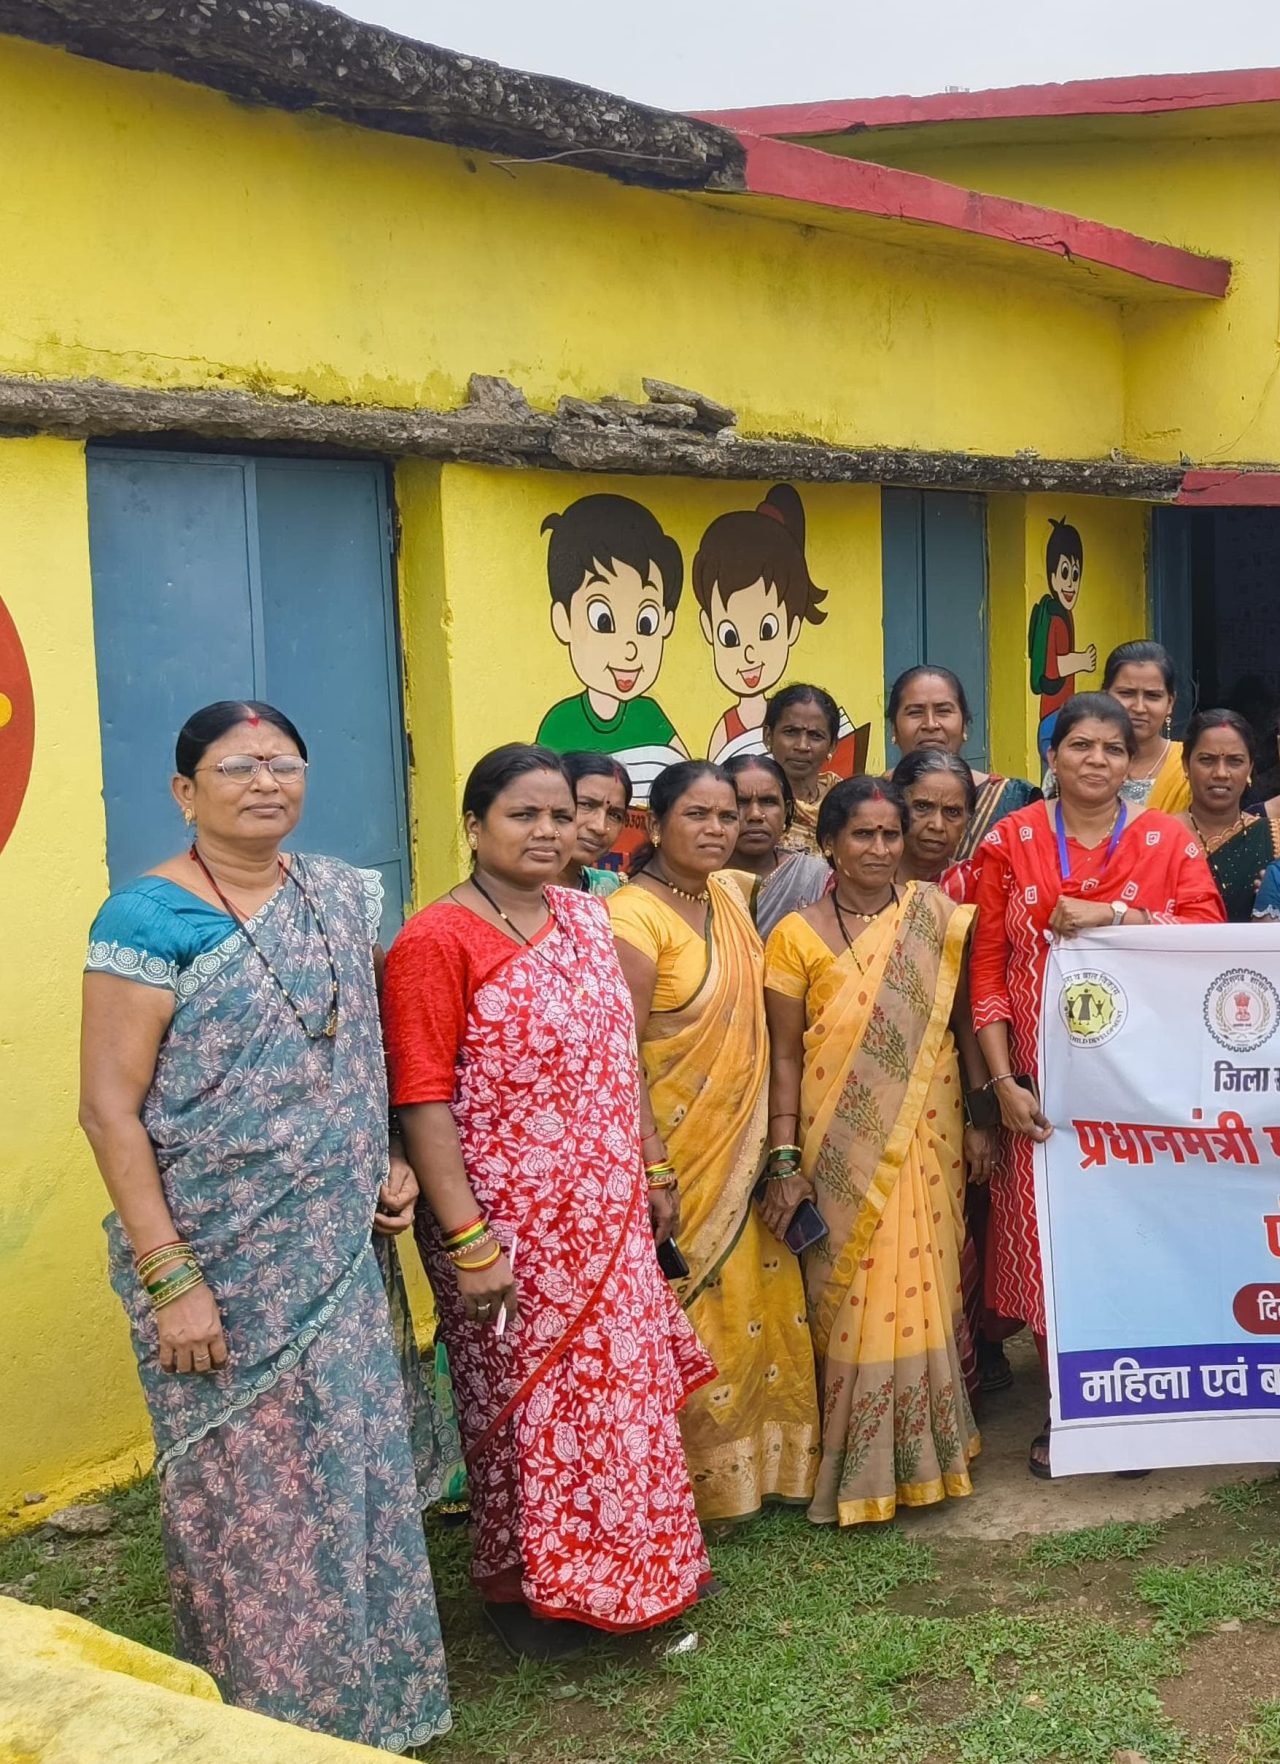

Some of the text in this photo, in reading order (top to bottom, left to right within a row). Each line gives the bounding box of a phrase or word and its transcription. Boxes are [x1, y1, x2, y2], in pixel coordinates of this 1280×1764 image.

[1214, 1060, 1270, 1092] जिला
[1073, 1108, 1260, 1170] प्रधानमंत्री
[1080, 1357, 1191, 1403] महिला
[1200, 1356, 1249, 1398] एवं
